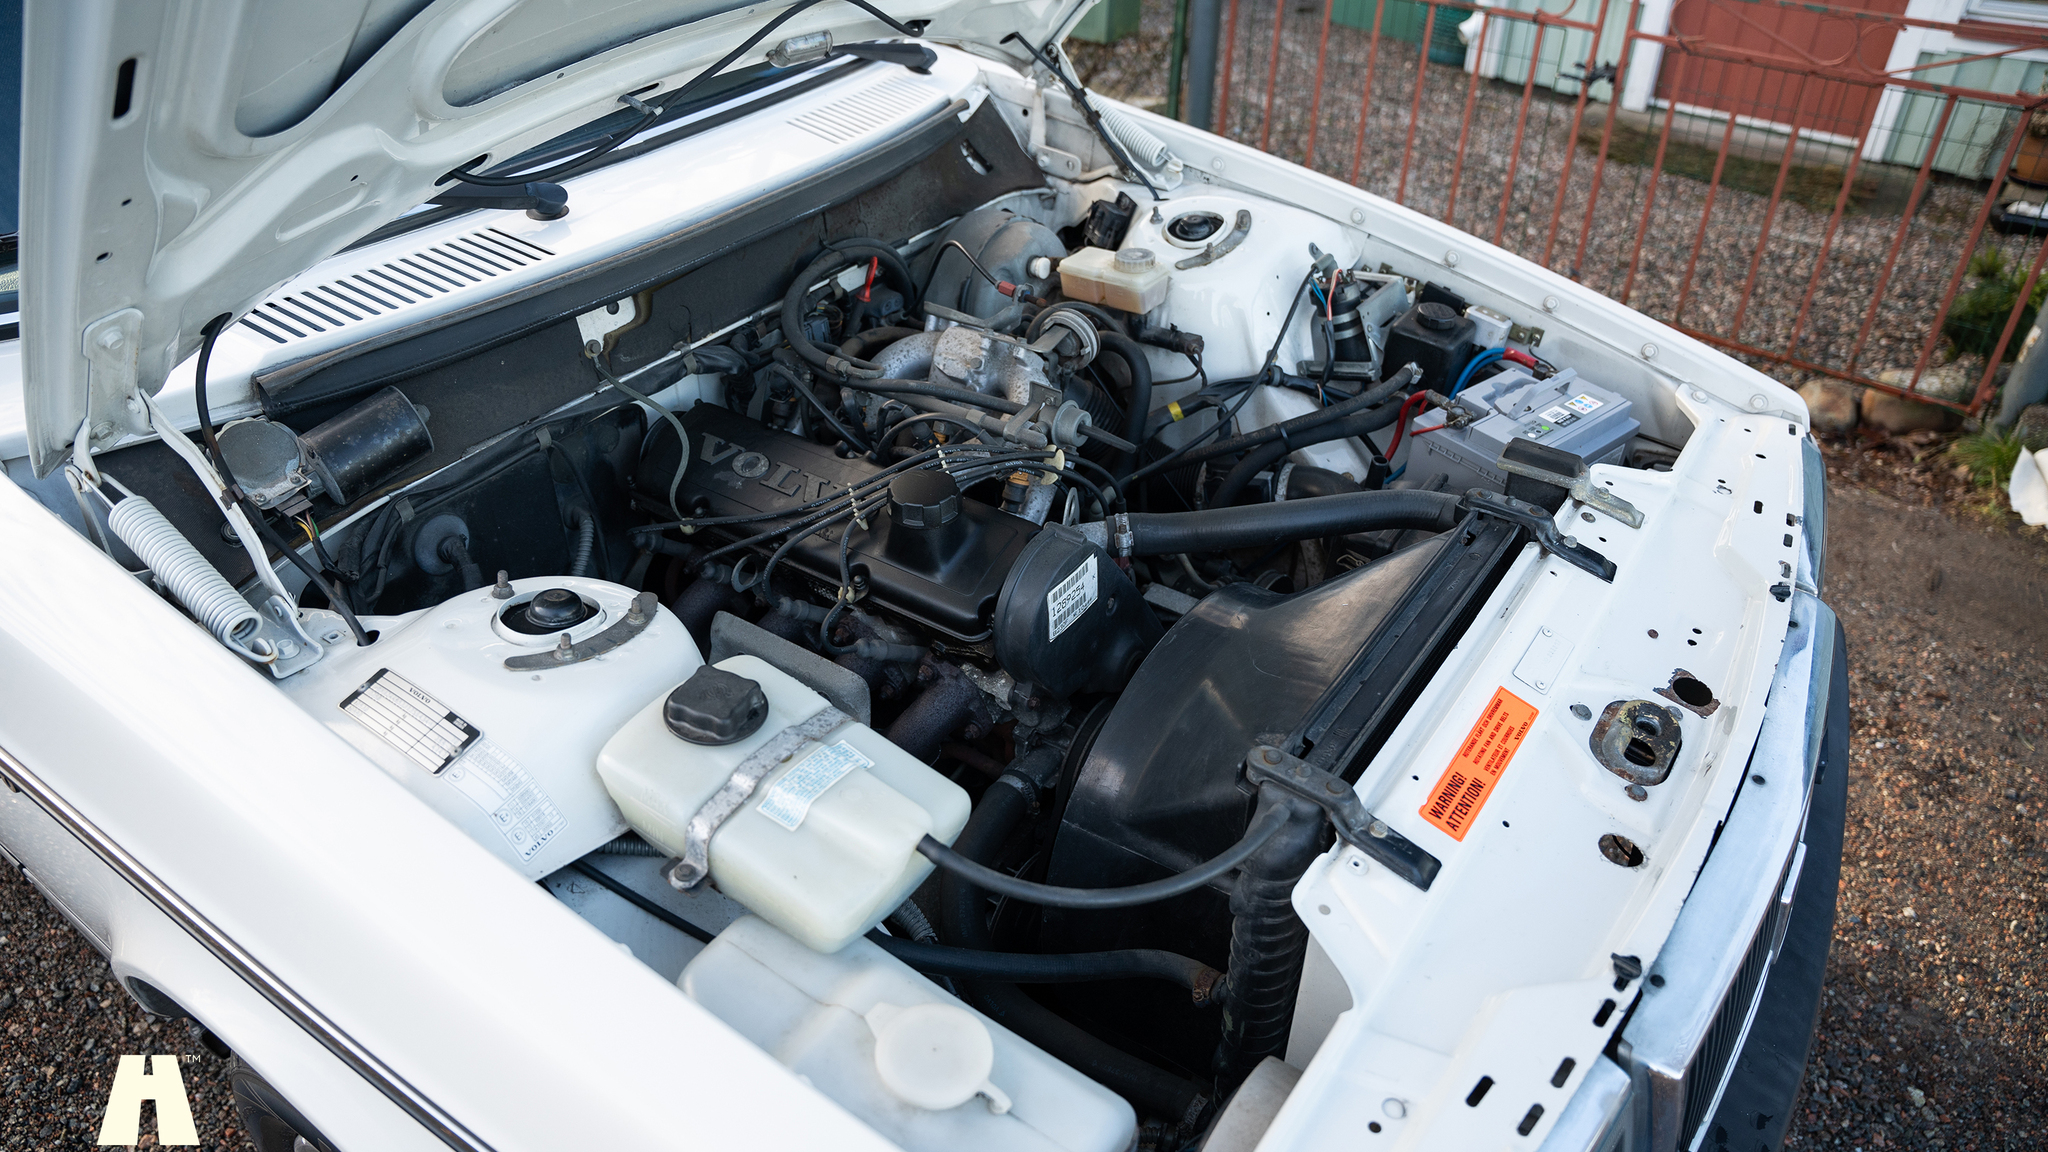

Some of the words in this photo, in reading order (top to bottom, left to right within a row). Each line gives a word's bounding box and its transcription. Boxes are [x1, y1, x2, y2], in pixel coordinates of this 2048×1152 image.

[1051, 582, 1085, 618] 1289254
[409, 687, 431, 704] VOLVO
[1484, 739, 1492, 748] FAN
[1489, 732, 1497, 740] AND
[1514, 721, 1529, 741] VOLVO
[1428, 771, 1467, 820] WARNING!
[1445, 777, 1486, 832] ATTENTION!
[525, 829, 554, 857] VOLVO
